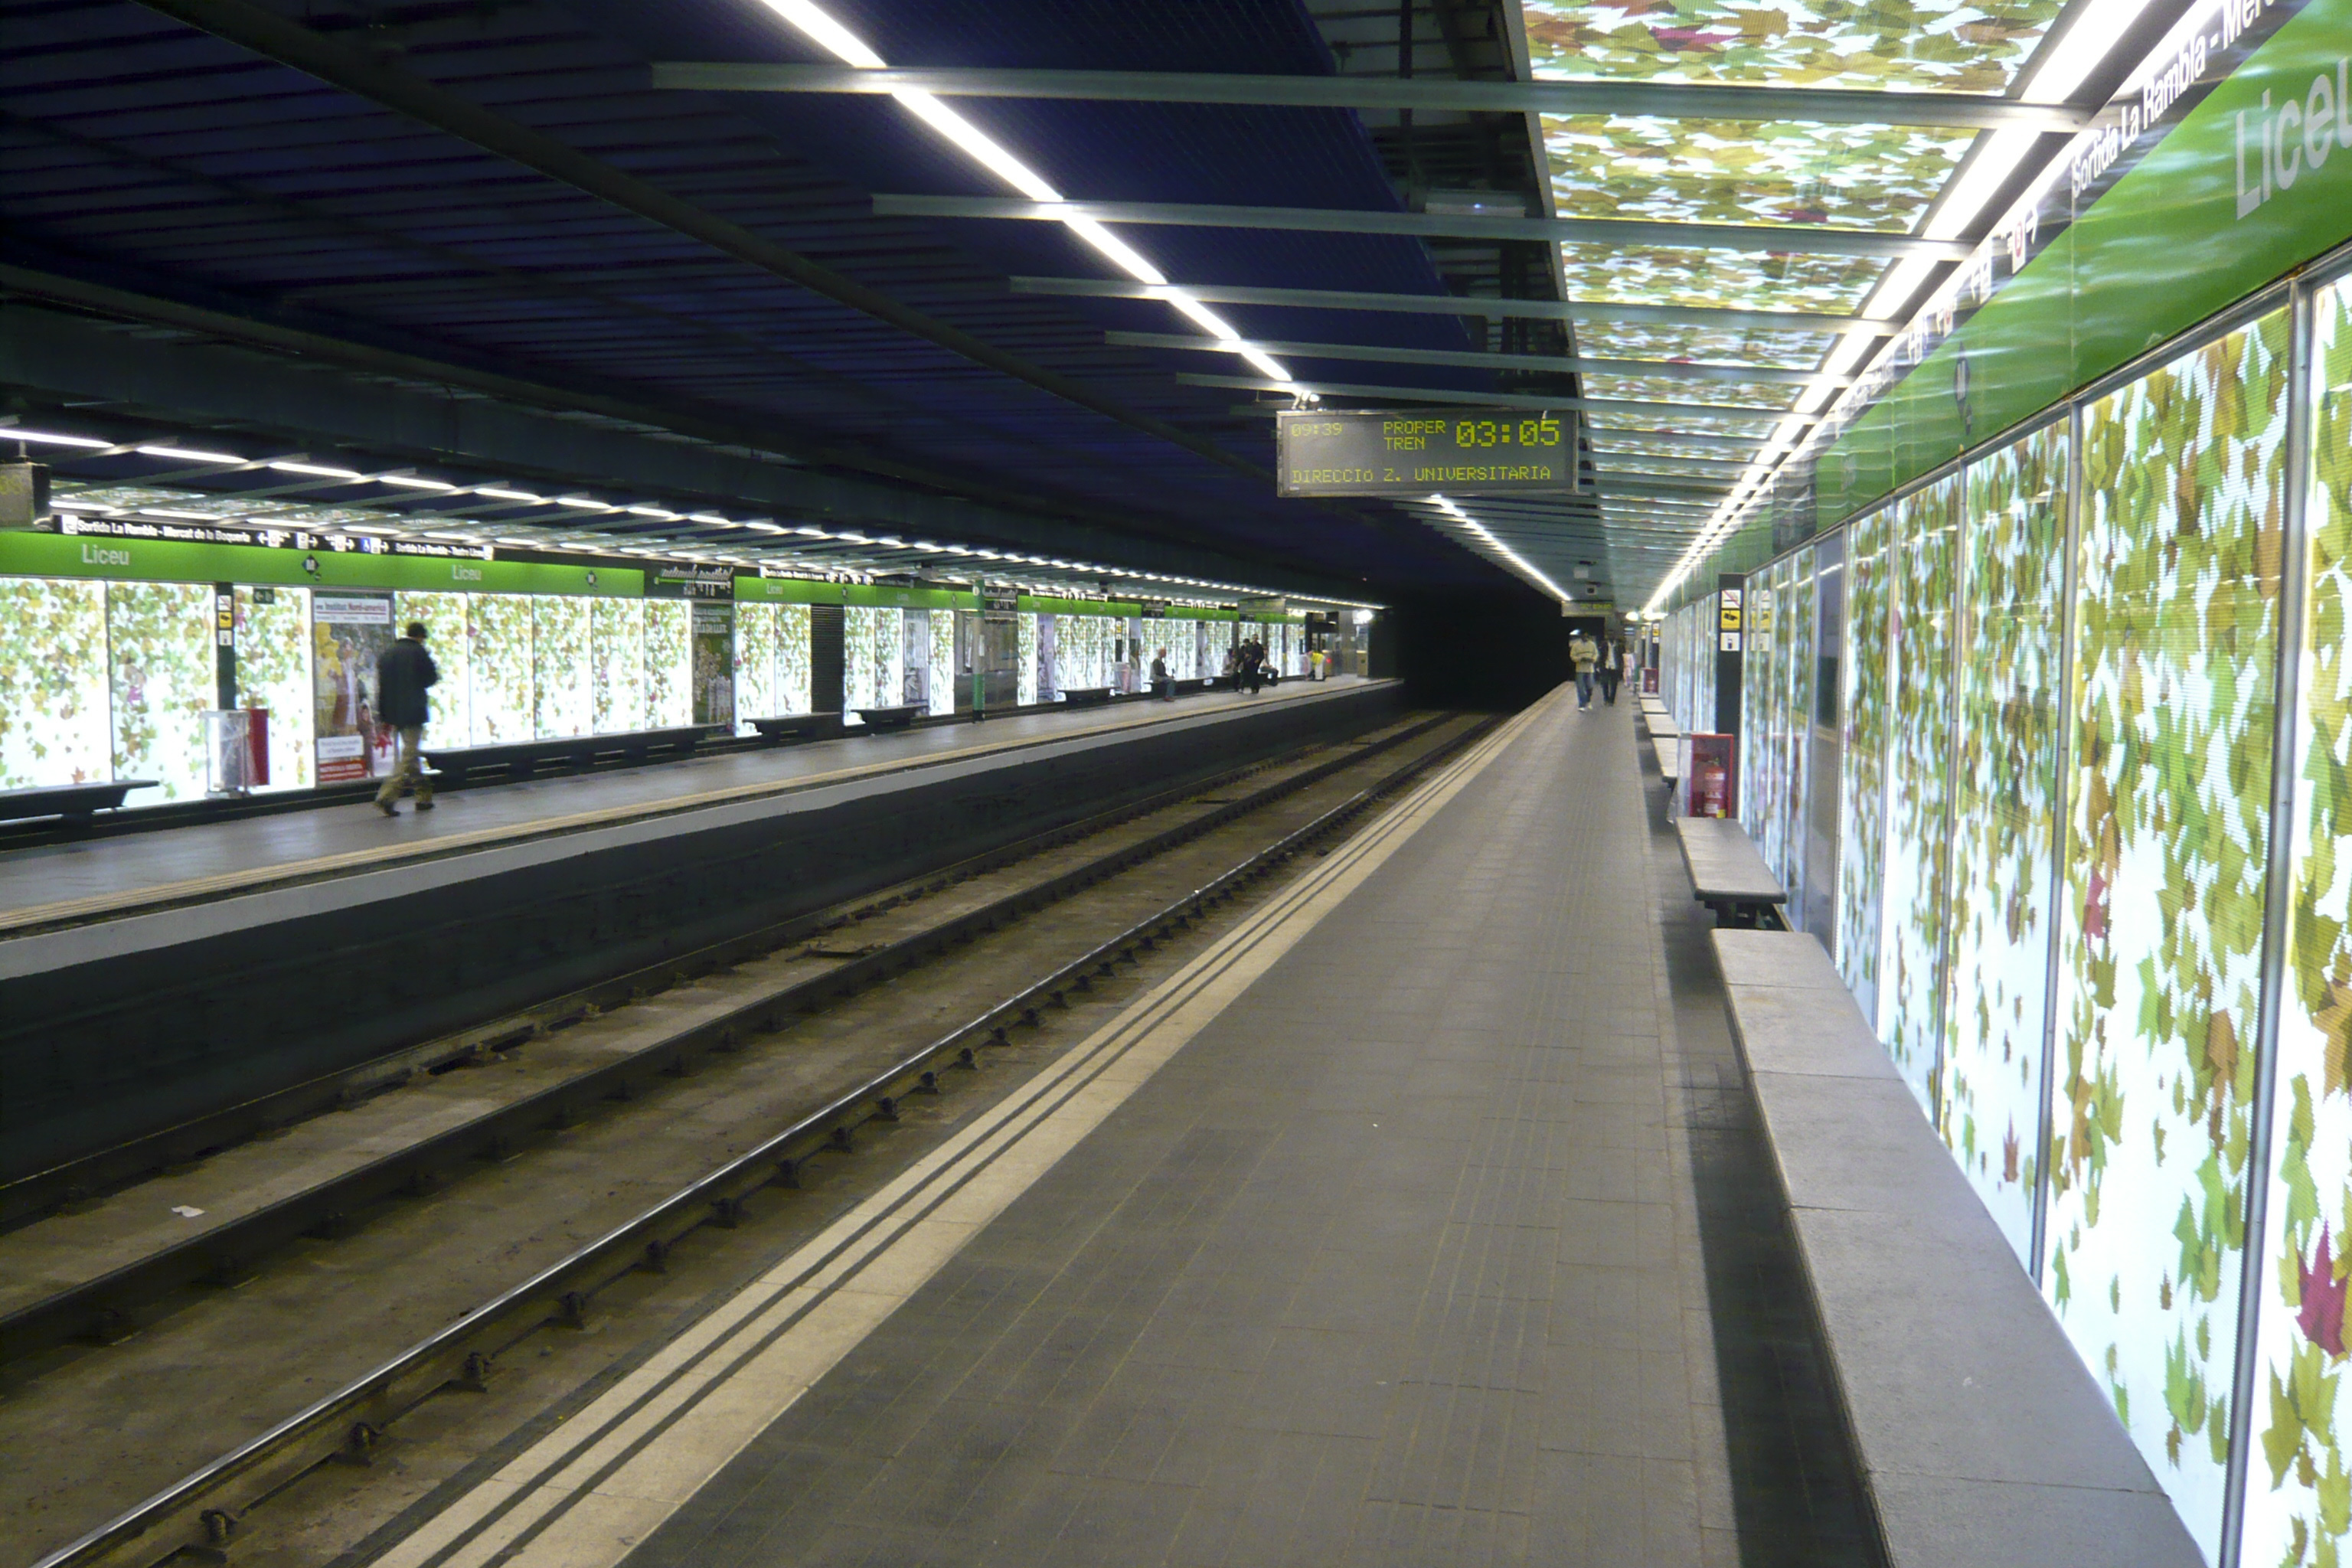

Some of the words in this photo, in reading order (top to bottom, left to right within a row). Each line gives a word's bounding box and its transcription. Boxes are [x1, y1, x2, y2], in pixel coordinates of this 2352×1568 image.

[2072, 122, 2118, 198] Sortida
[2122, 105, 2139, 152] La
[2144, 35, 2205, 129] Rambla
[2223, 0, 2274, 50] Mer
[1292, 423, 1342, 437] 09:39
[1383, 420, 1446, 434] PROPER
[1456, 420, 1560, 447] 03:05
[1384, 436, 1426, 450] TREN
[1383, 468, 1400, 482] Z.
[78, 519, 110, 533] Sortida
[111, 522, 123, 534] La
[163, 525, 193, 539] Mercat
[82, 543, 129, 565] Liceu
[452, 564, 482, 580] Liceu
